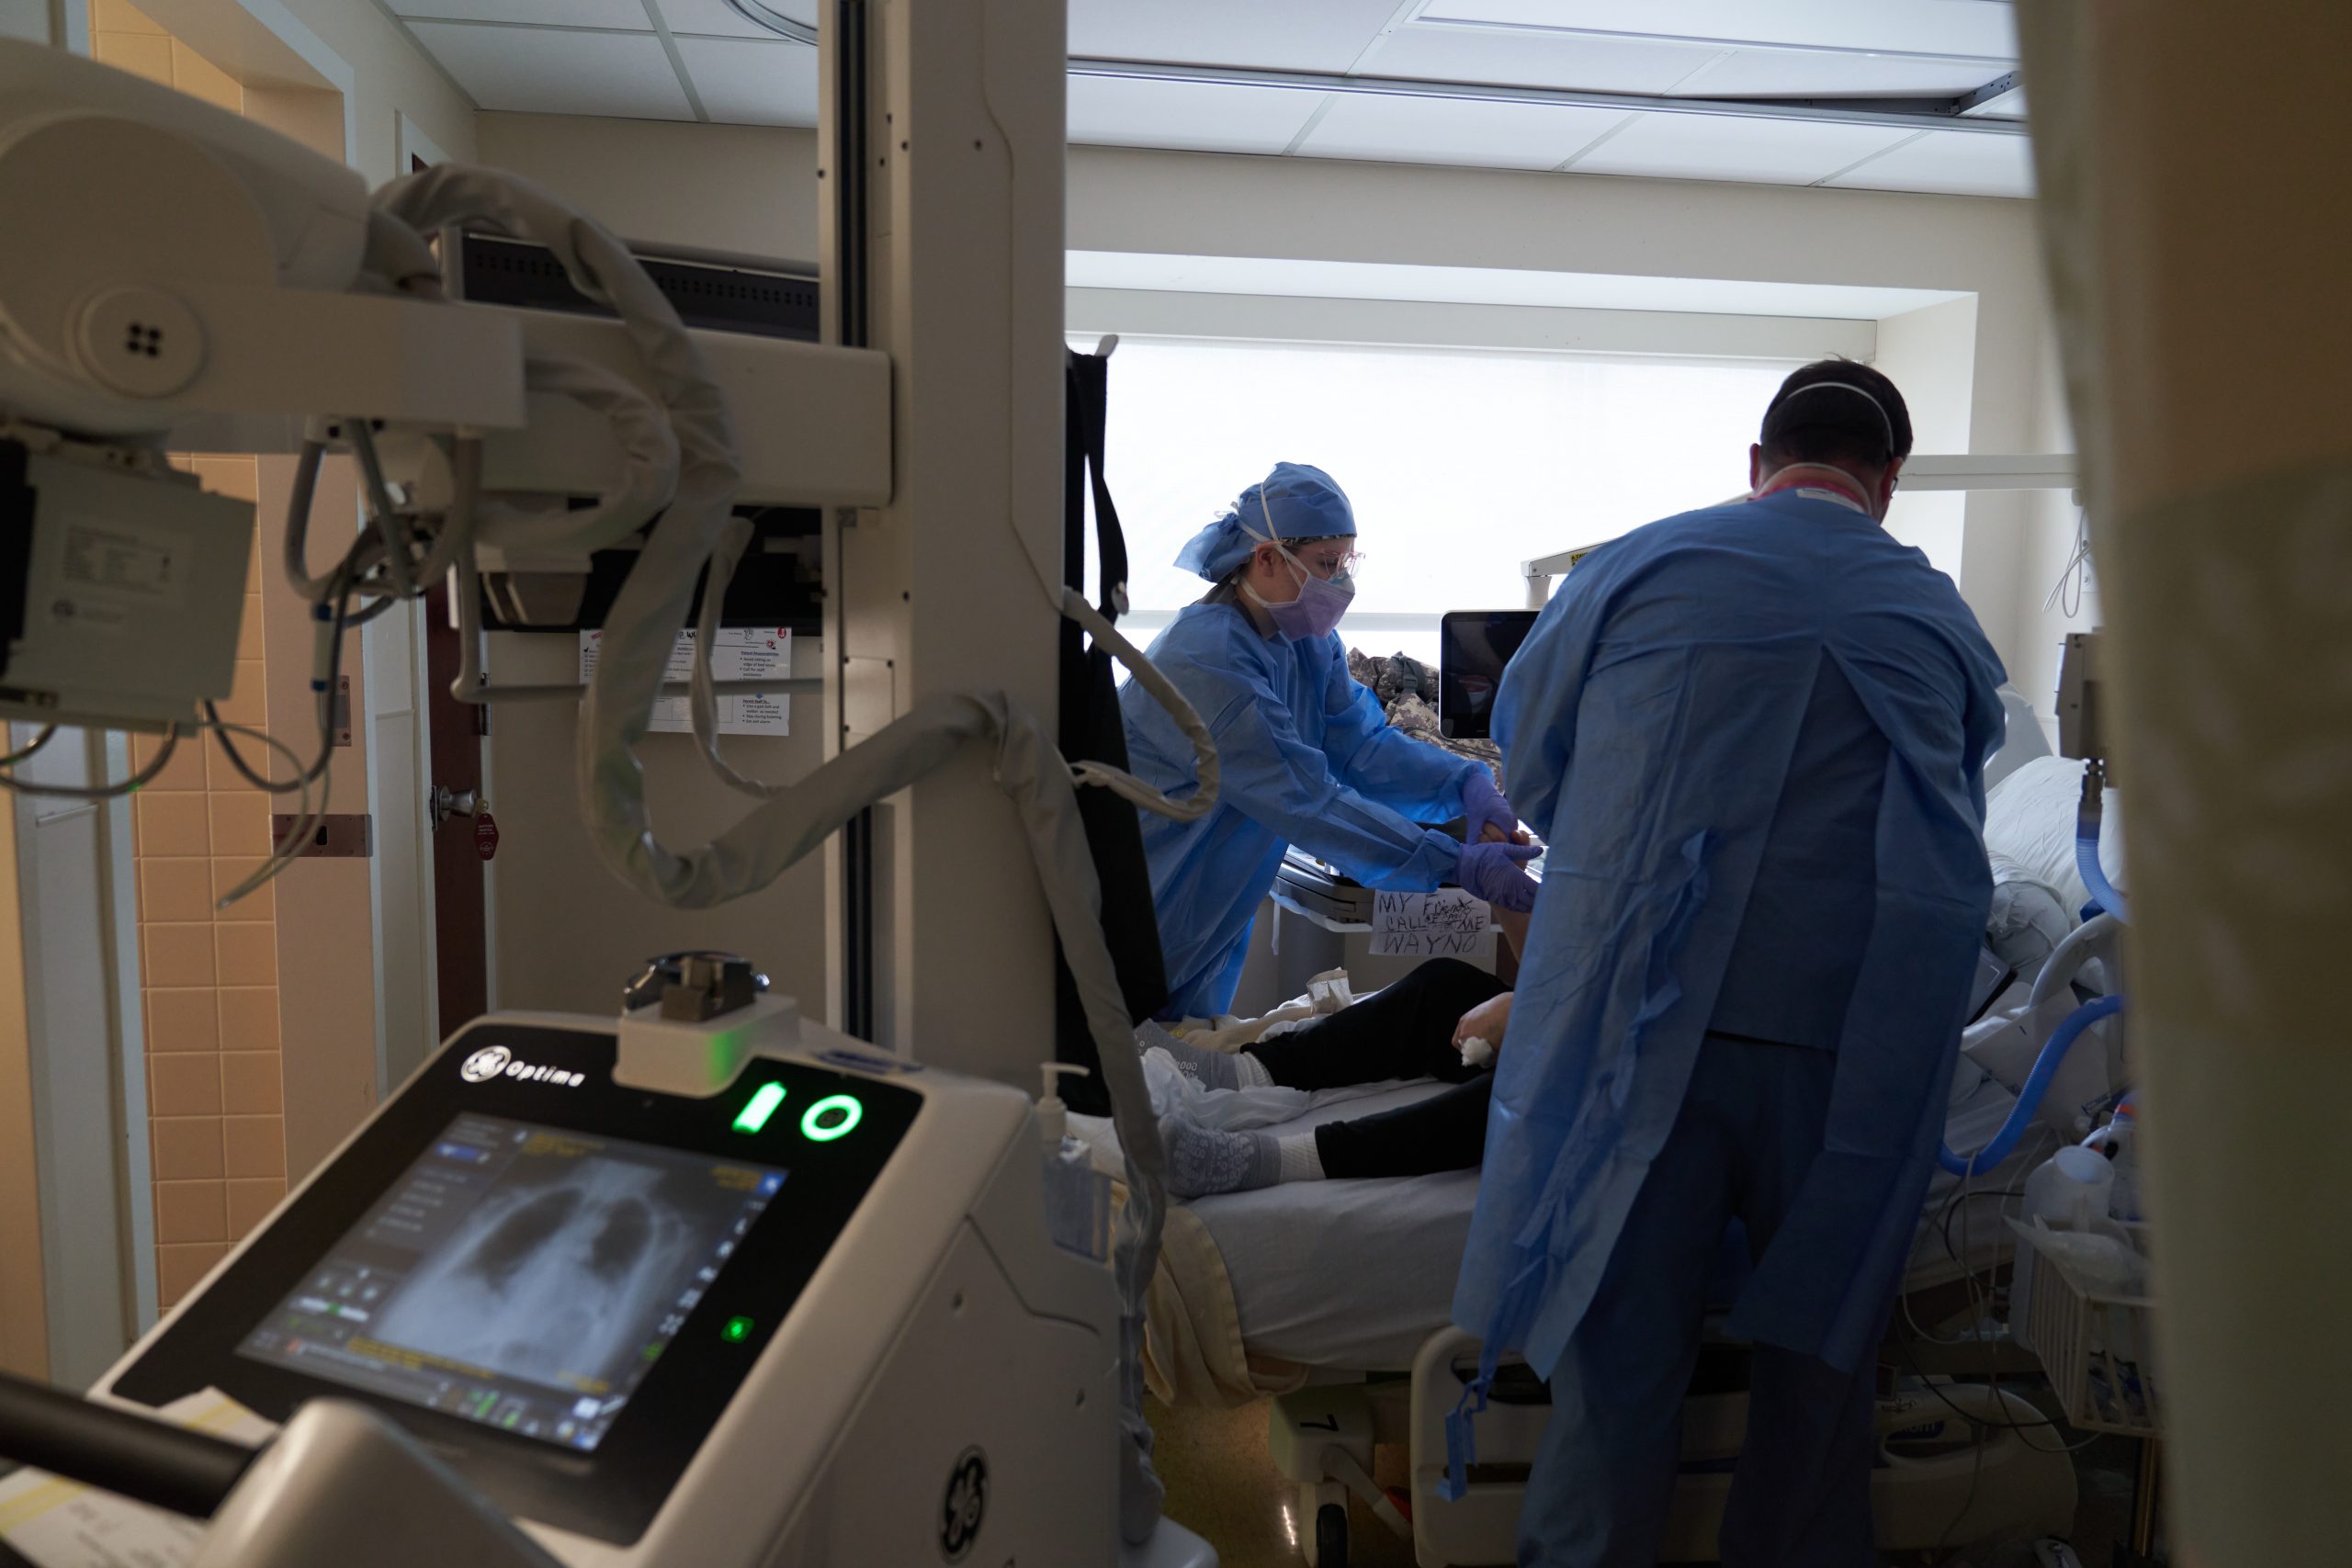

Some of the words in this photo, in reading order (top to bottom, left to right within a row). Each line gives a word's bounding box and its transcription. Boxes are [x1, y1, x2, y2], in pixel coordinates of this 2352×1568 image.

[1379, 892, 1414, 913] MY
[1385, 915, 1426, 931] CALL
[1457, 916, 1486, 931] ME
[505, 1059, 586, 1088] Optima
